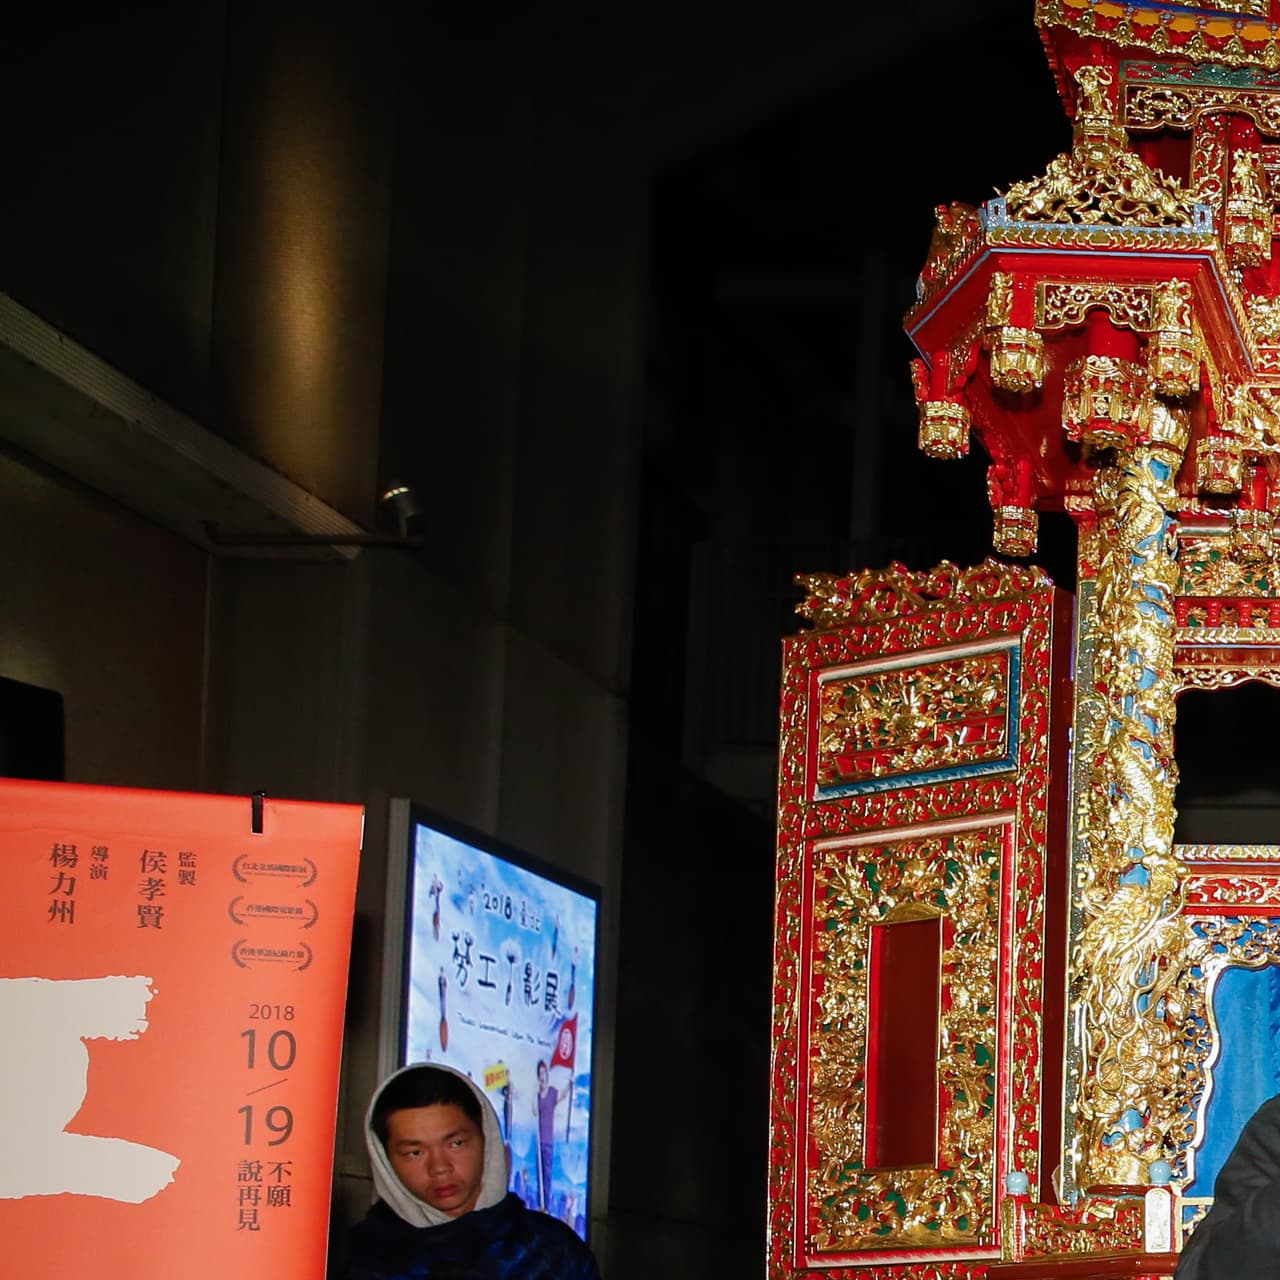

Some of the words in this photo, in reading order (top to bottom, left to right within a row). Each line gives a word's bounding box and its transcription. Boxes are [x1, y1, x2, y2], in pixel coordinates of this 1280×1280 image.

[47, 842, 79, 925] 楊力州
[88, 845, 110, 881] 導演
[176, 851, 198, 887] 監製
[136, 848, 168, 930] 侯孝賢
[484, 894, 512, 920] 2018
[249, 1004, 295, 1021] 2018
[240, 1029, 297, 1071] 10
[238, 1105, 294, 1147] 19
[237, 1160, 264, 1232] 說再見
[267, 1161, 292, 1208] 不願
